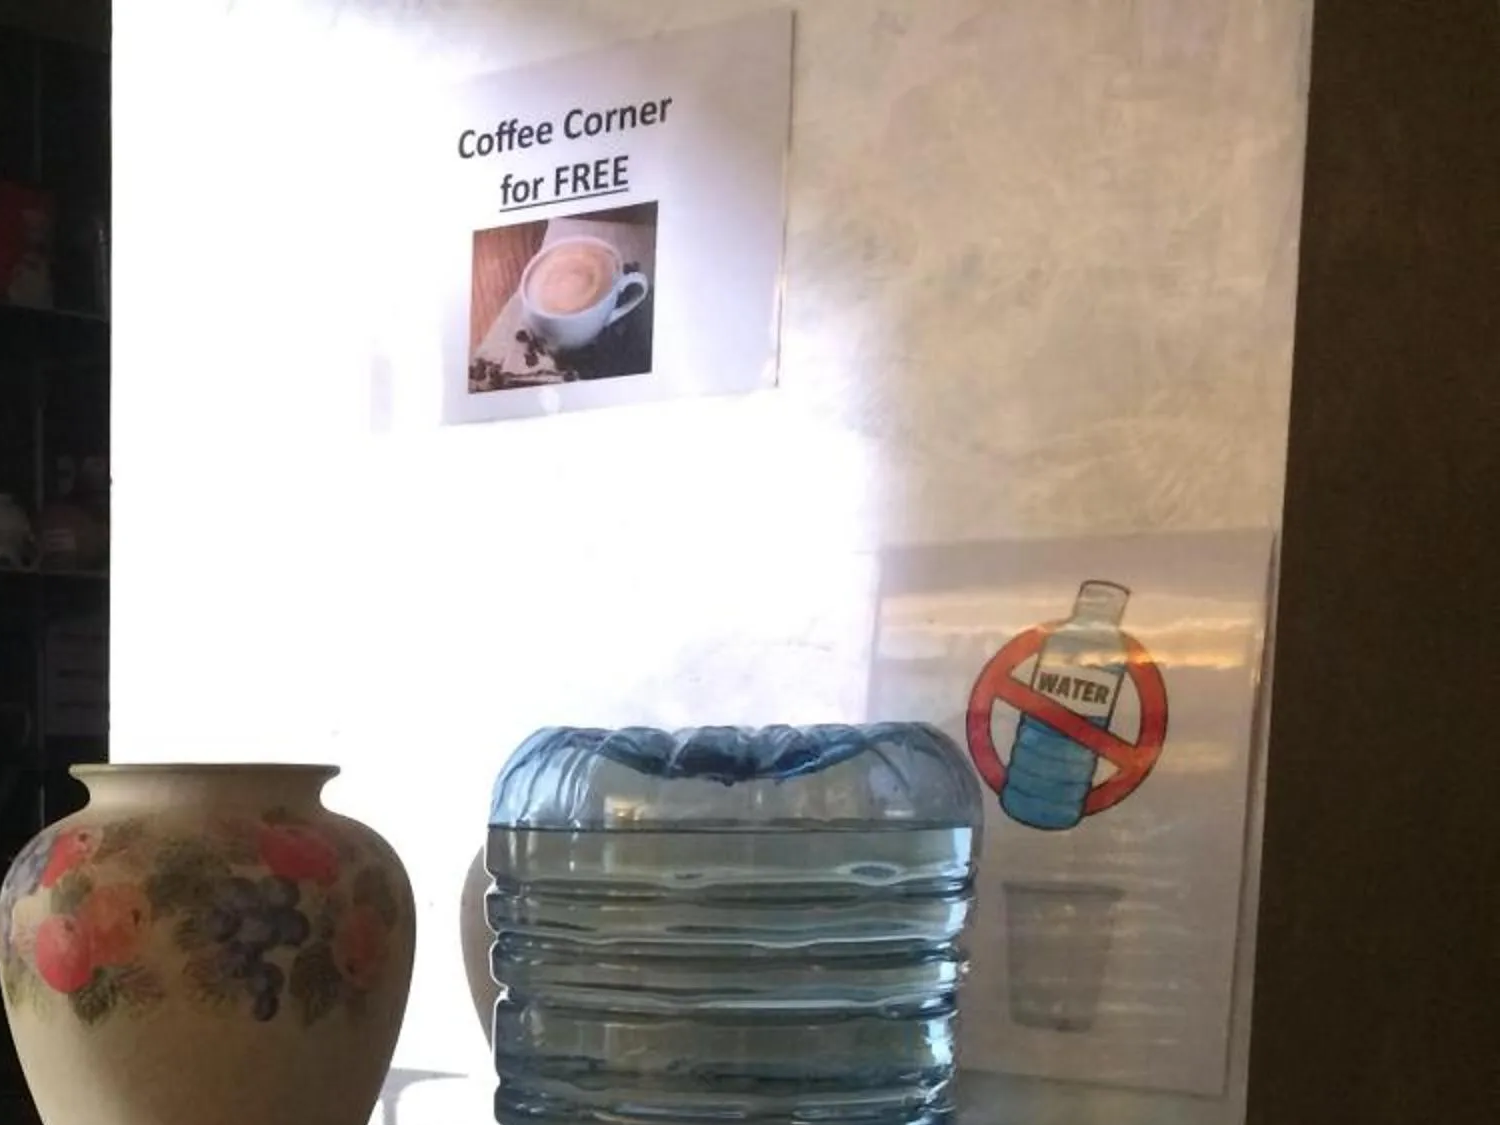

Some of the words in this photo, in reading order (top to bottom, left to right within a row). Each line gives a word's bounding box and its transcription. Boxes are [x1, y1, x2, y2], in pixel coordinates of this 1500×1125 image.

[457, 118, 553, 160] Coffee
[563, 96, 673, 140] Corner
[500, 173, 545, 206] for
[554, 155, 630, 197] FREE
[1038, 671, 1110, 705] WATER
